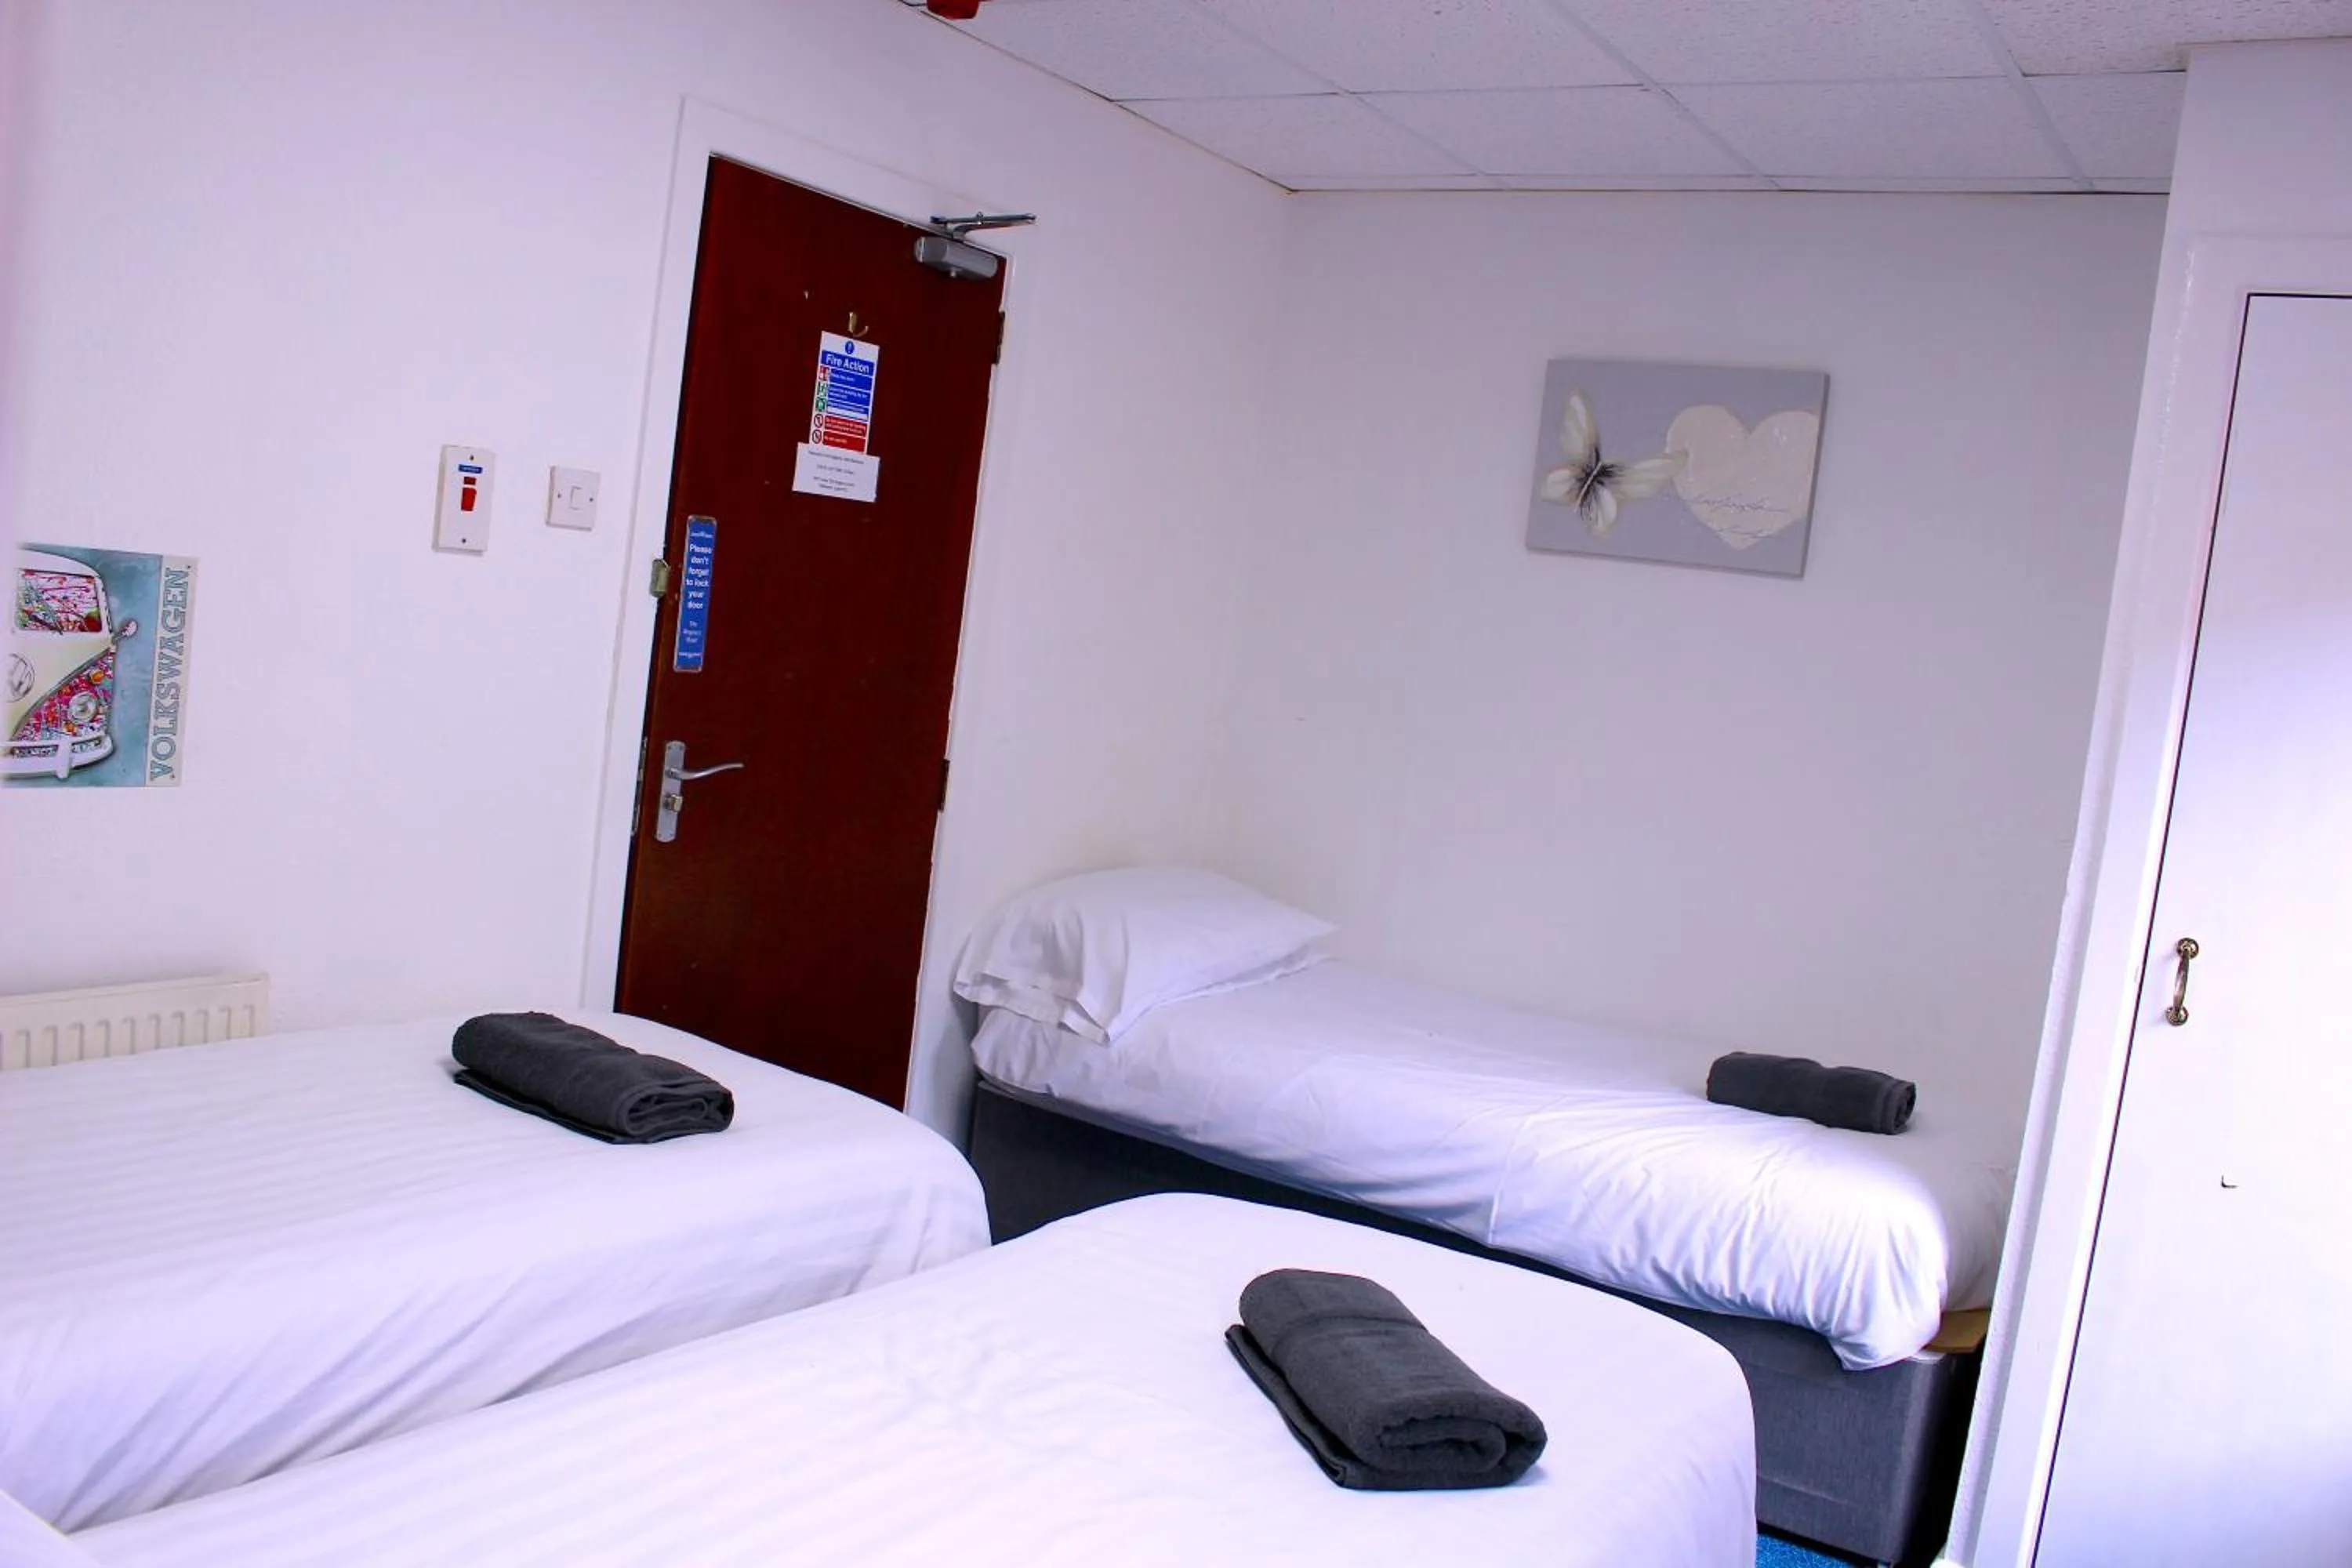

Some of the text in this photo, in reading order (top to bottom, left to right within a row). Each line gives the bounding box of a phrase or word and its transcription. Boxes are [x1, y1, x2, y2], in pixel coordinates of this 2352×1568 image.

[826, 354, 869, 374] Fire Action
[690, 543, 712, 554] Please
[688, 567, 710, 577] forget
[688, 590, 704, 599] your
[150, 567, 190, 781] VOLKSWAGEN
